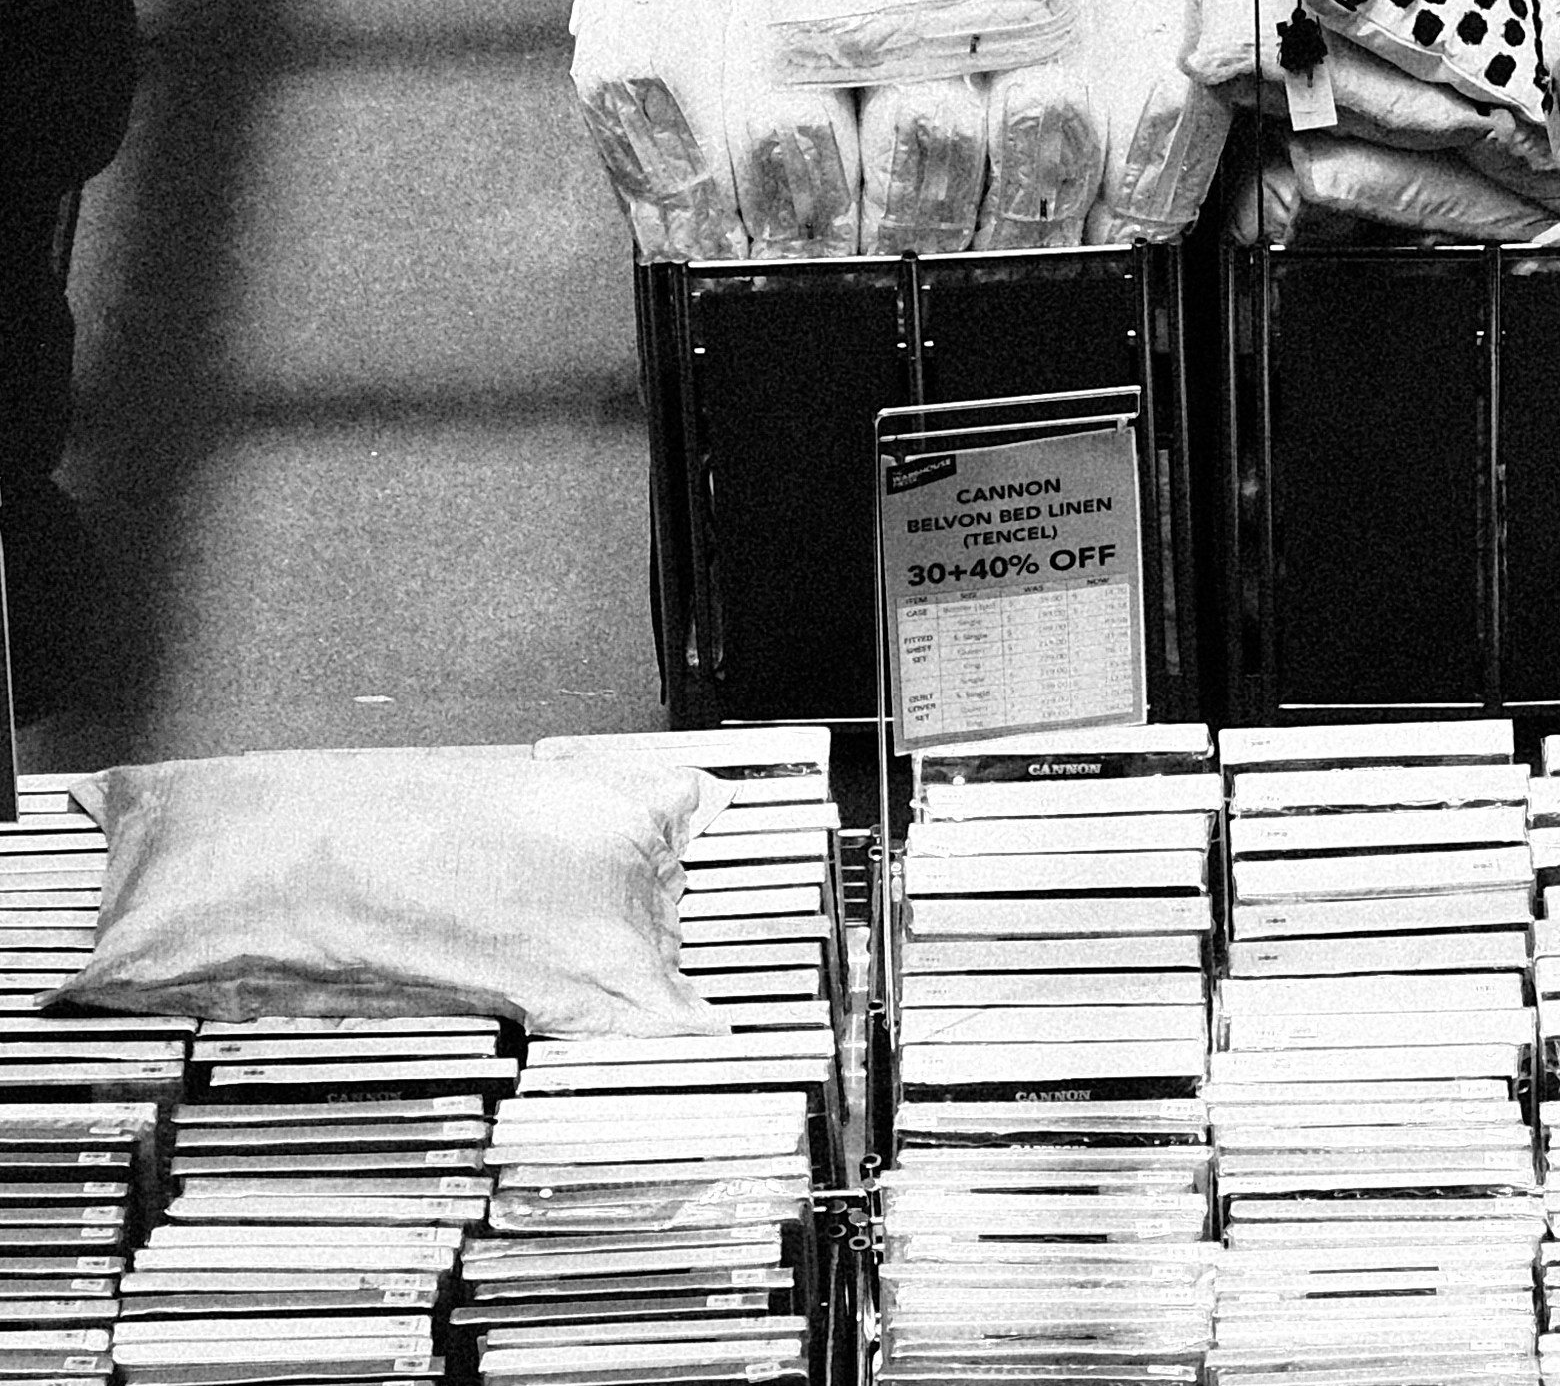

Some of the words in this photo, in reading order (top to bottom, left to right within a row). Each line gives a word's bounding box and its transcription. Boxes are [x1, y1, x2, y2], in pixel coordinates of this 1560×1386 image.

[956, 478, 1061, 504] CANNON
[907, 511, 991, 534] BELVON
[999, 505, 1042, 524] BED
[1048, 497, 1112, 518] LINEN
[963, 525, 1058, 549] (TENCEL)
[907, 553, 1040, 587] 30+40%
[1049, 544, 1115, 571] OFF
[1028, 764, 1101, 775] CANNON
[1015, 1090, 1091, 1102] CANNON
